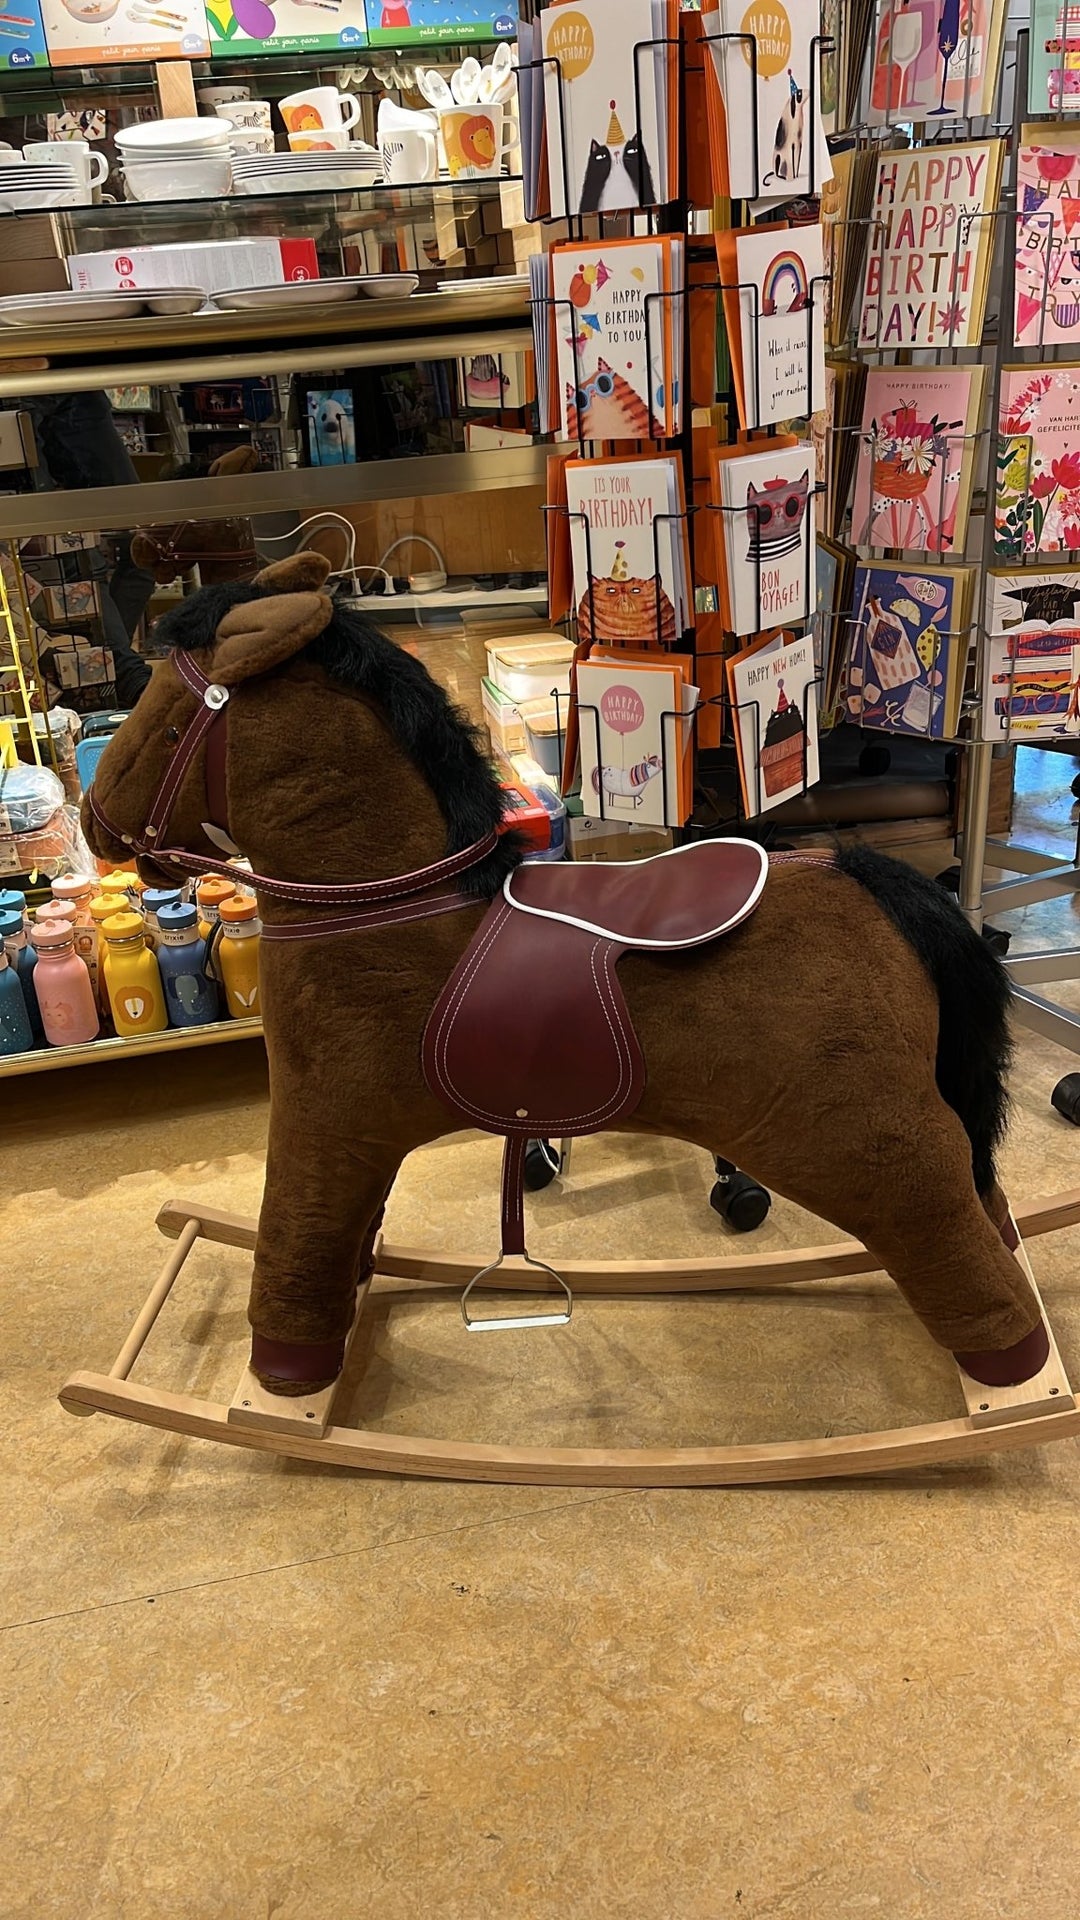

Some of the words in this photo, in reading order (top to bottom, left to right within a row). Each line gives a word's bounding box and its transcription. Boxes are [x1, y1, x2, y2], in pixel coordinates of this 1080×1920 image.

[495, 21, 514, 32] 6m+
[553, 25, 588, 48] HAPPY
[750, 13, 786, 38] HAPPY
[341, 32, 360, 43] 6m+
[12, 53, 31, 64] 6m+
[877, 153, 986, 205] HAPPY
[872, 202, 981, 251] HAPPY
[866, 251, 972, 297] BIRTH
[612, 289, 641, 304] HAPPY
[605, 309, 646, 325] BIRTHDA
[861, 301, 937, 343] DAY!
[608, 331, 619, 343] TO
[610, 475, 632, 494] YOUR
[579, 497, 653, 530] BIRTHDAY!
[761, 569, 780, 593] BON
[759, 579, 799, 613] OYAGE!
[747, 664, 770, 687] HAPPY
[772, 656, 788, 677] NEW
[789, 649, 806, 667] HOME!
[607, 695, 639, 712] HAPPY
[604, 709, 643, 726] BIRTHDAY!
